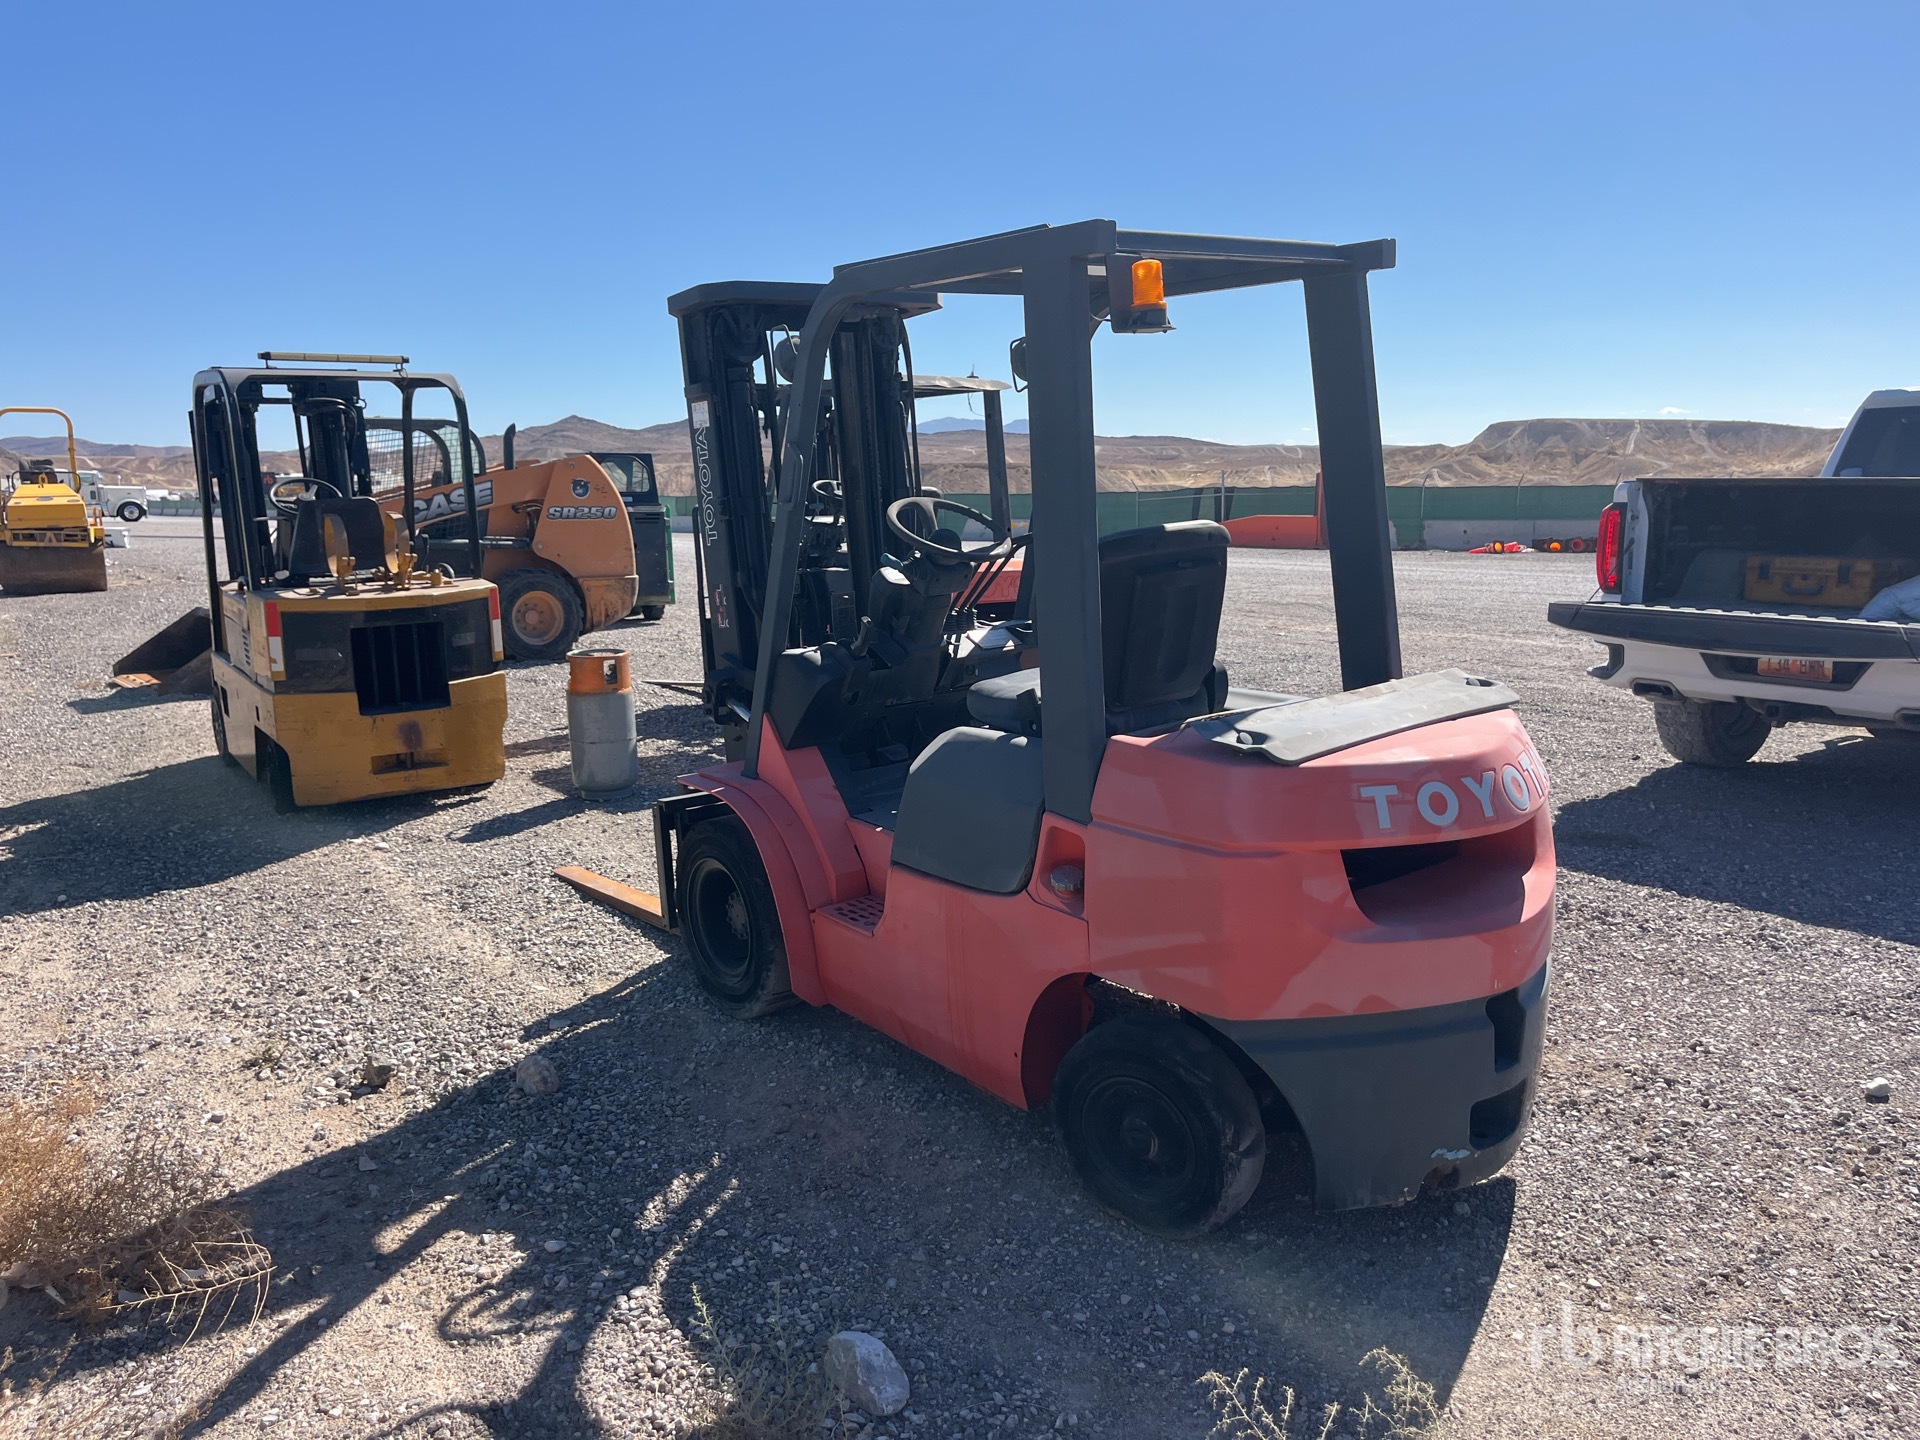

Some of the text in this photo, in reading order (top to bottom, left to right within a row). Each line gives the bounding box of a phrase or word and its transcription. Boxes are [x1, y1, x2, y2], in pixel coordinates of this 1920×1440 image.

[413, 480, 495, 523] CASE
[695, 427, 718, 546] TOYOTA
[547, 506, 617, 520] SR250
